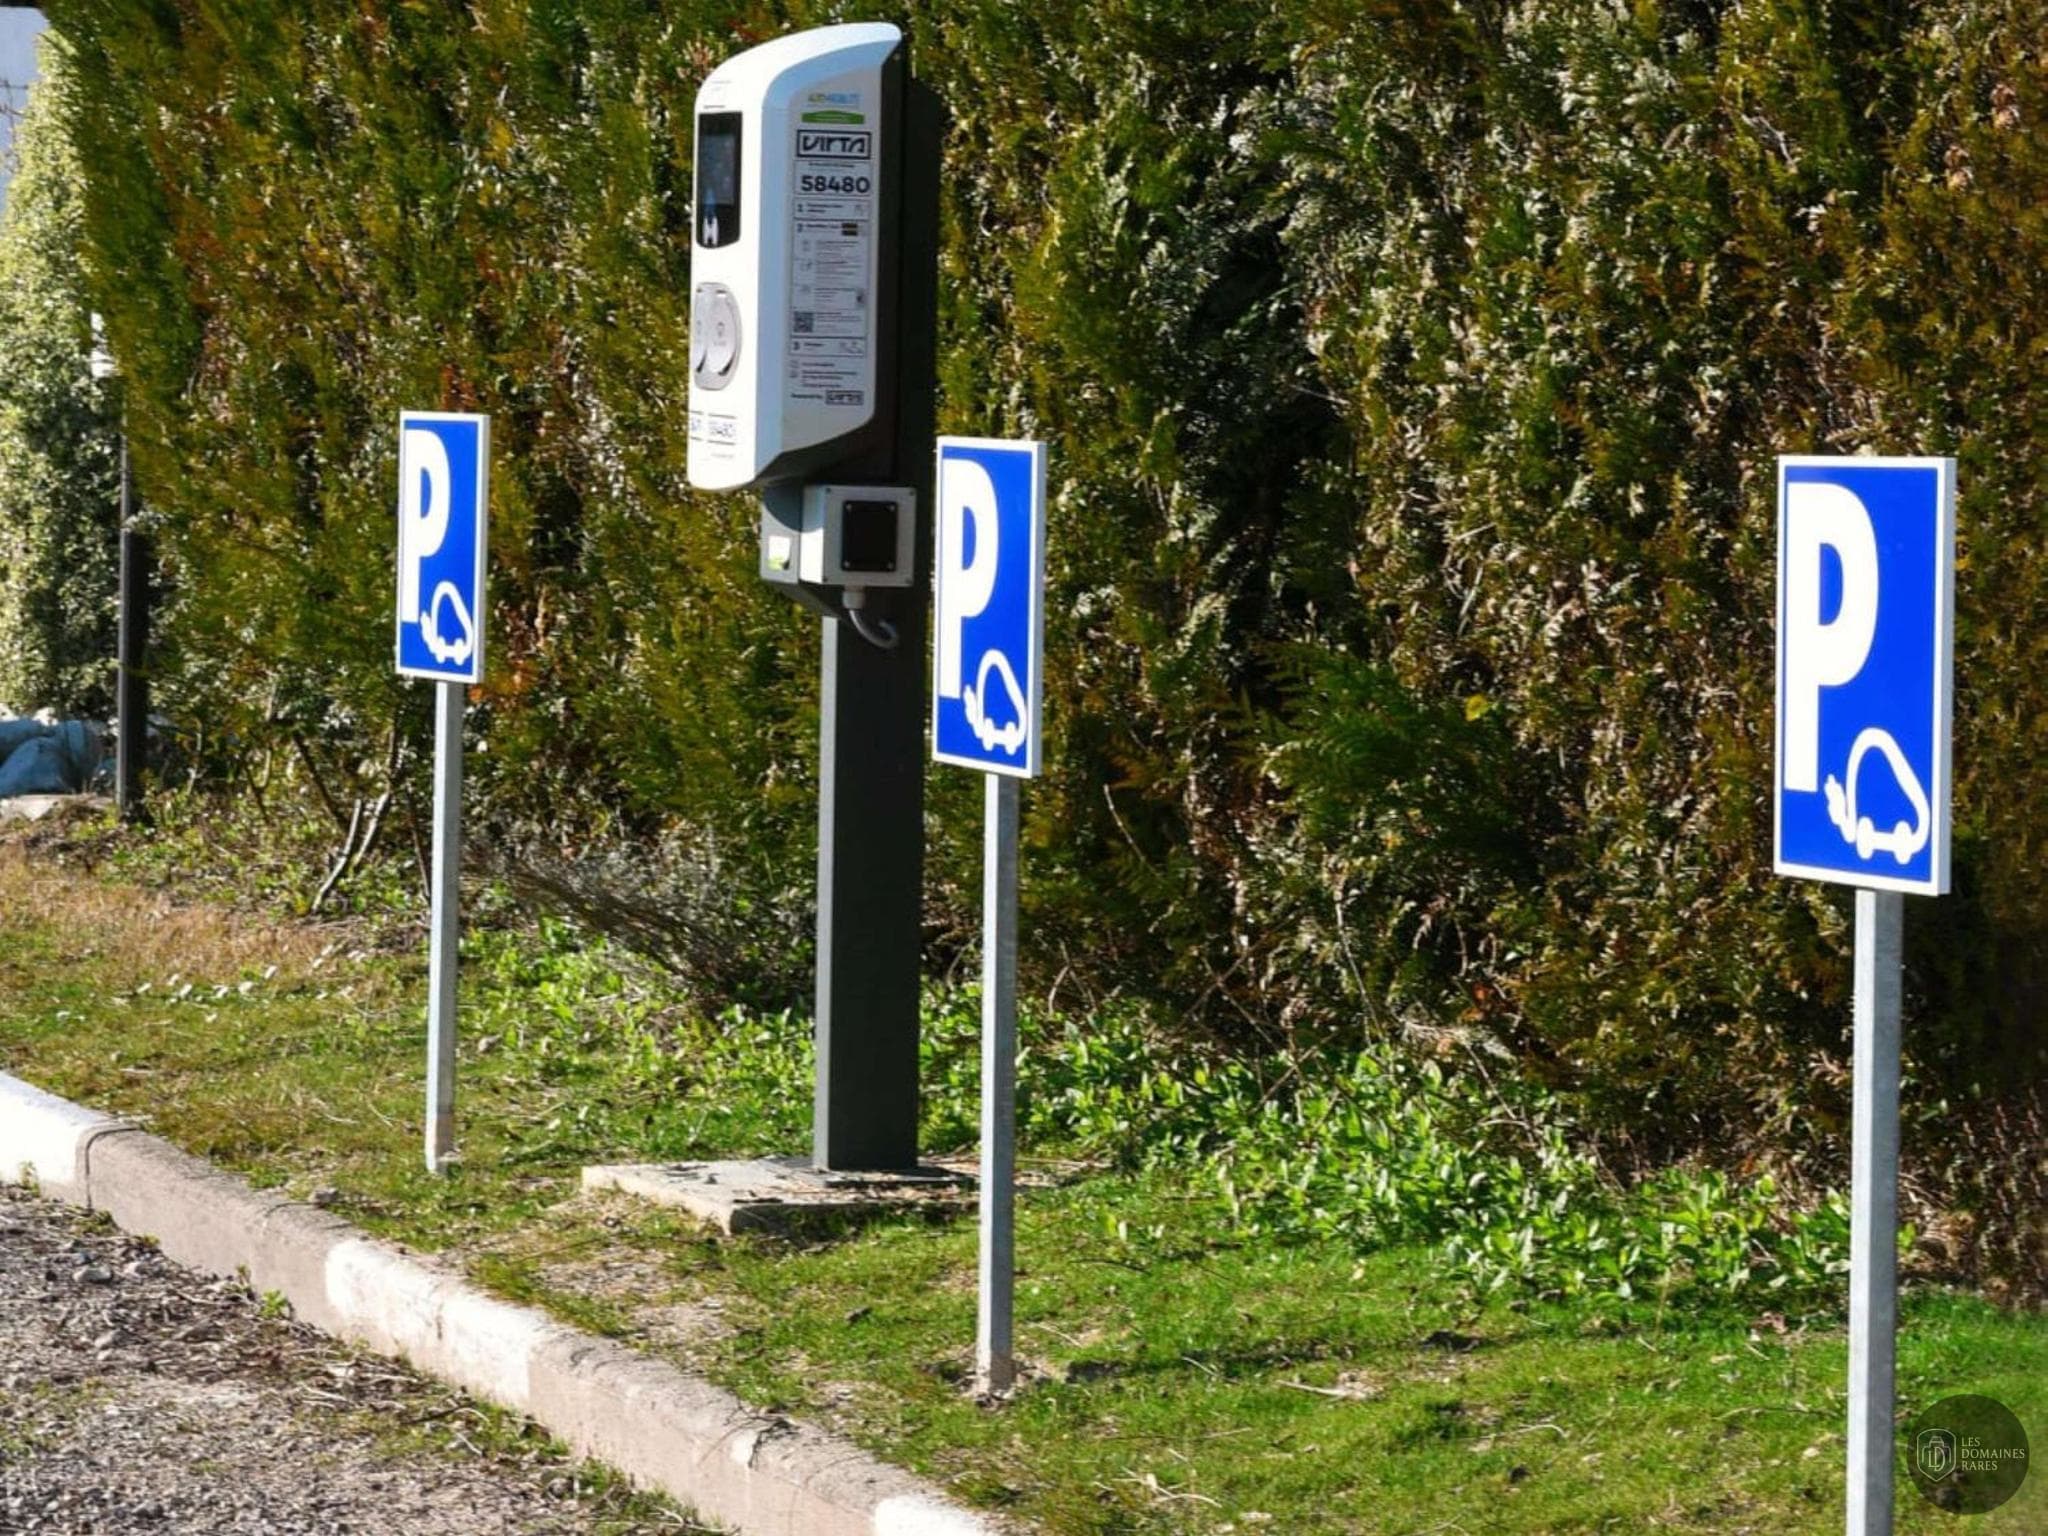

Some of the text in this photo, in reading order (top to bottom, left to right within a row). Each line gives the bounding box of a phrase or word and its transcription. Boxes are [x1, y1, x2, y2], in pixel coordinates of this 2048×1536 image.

[801, 175, 870, 194] 58480
[401, 429, 450, 622] P
[939, 458, 999, 699] P
[1785, 481, 1879, 792] P
